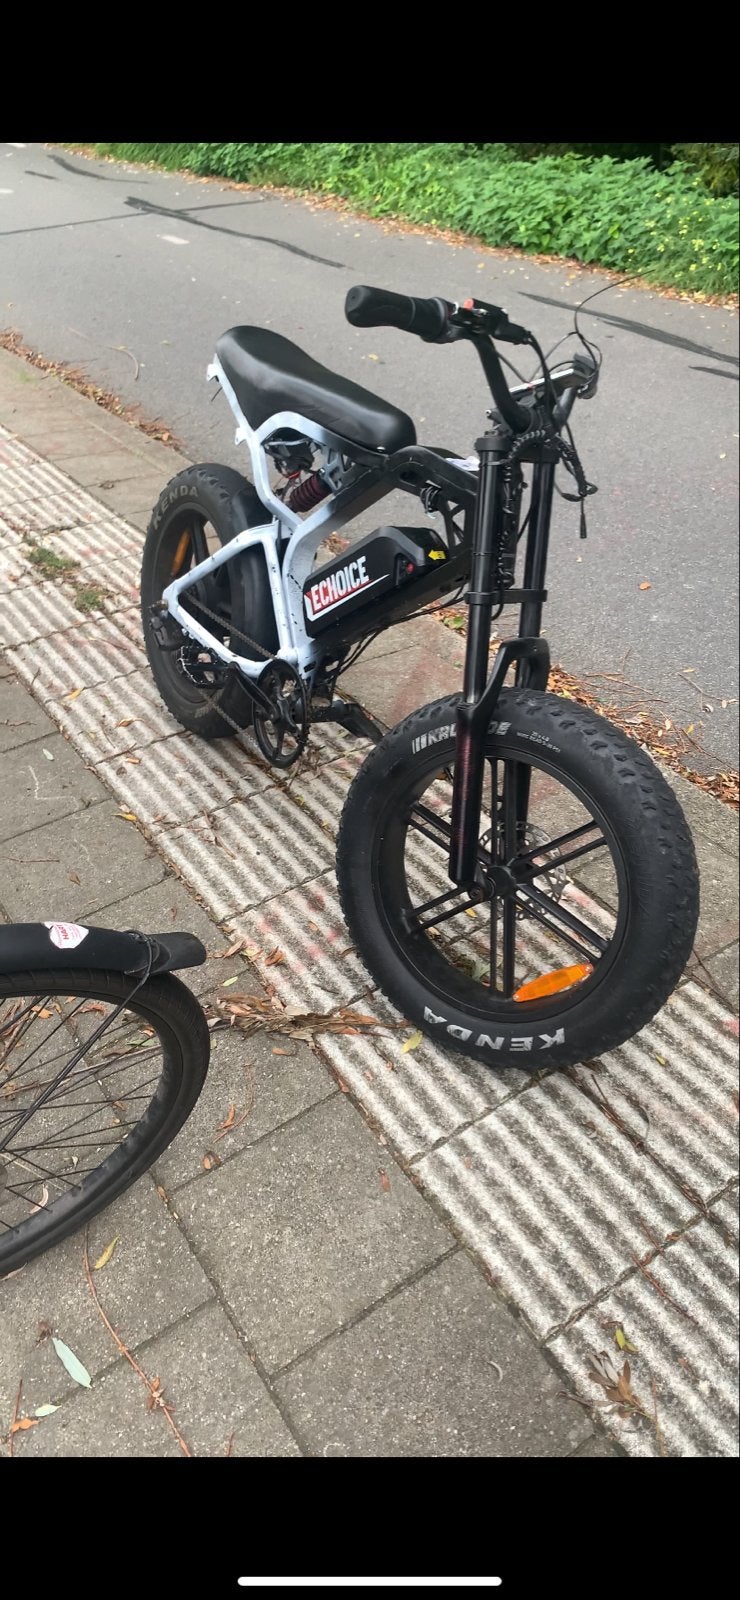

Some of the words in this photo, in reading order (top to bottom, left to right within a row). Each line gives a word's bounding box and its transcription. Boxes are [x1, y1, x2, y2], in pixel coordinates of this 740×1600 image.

[152, 485, 199, 530] KENDA
[310, 555, 370, 612] ECHOICE
[423, 1006, 566, 1052] KENDA
